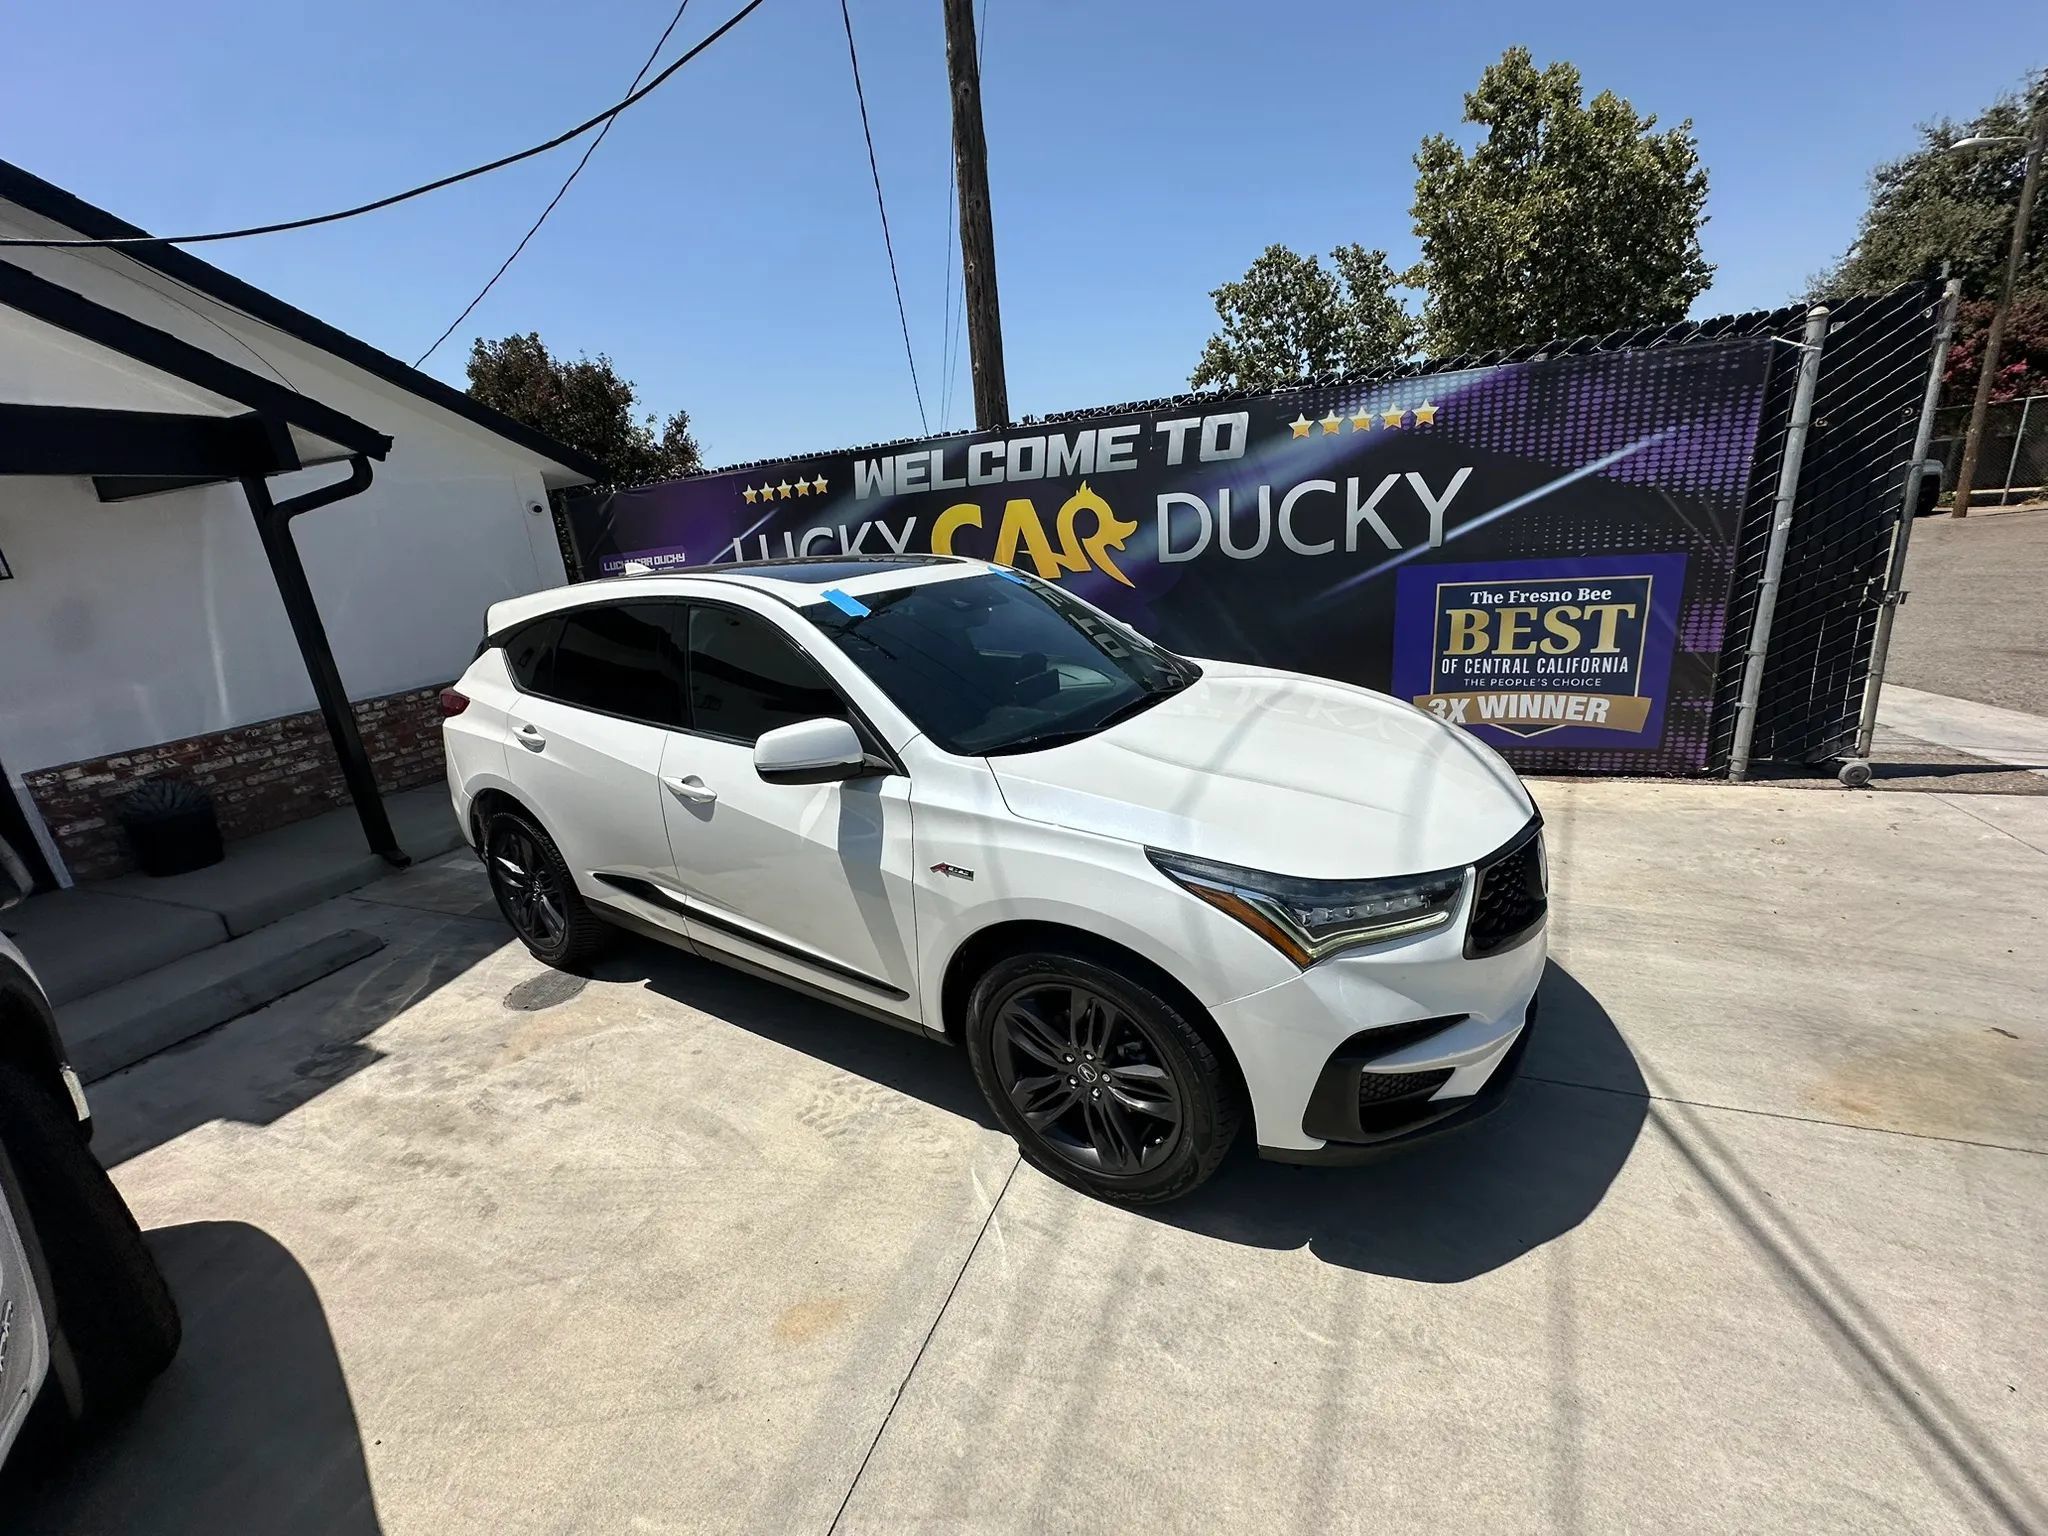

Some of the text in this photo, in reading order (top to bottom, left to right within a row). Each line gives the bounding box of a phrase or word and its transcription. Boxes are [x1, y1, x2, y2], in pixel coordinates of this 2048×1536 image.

[854, 411, 1249, 500] WELCOME TO
[931, 480, 1138, 588] CAR
[1157, 467, 1473, 563] DUCKY
[1470, 588, 1612, 604] The Fresno Bee
[1443, 604, 1636, 655] BEST
[1441, 656, 1629, 674] OF CENTRAL CALIFORNIA
[1464, 678, 1602, 687] THE PEOPLE'S CHOICE
[1428, 694, 1611, 723] 3X WINNER
